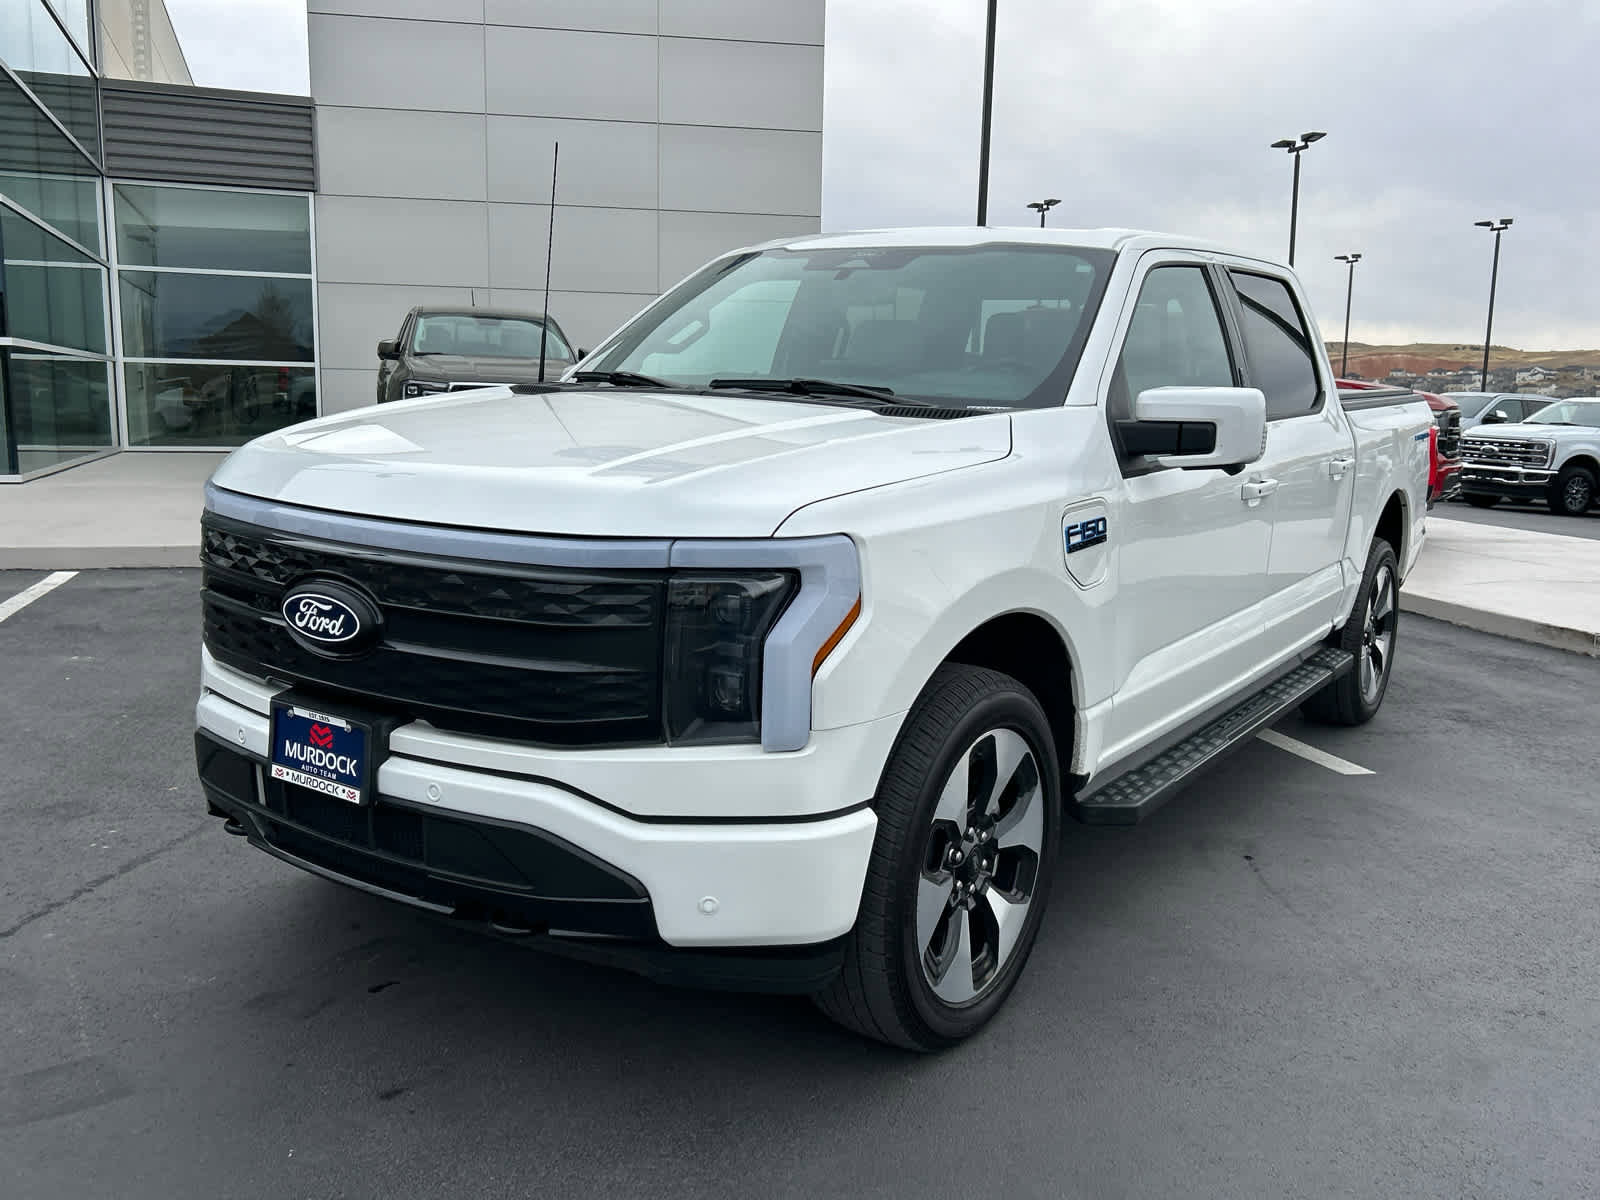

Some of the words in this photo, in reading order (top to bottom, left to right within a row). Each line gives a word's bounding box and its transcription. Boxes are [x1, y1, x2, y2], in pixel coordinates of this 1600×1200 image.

[295, 599, 345, 636] Ford
[285, 739, 357, 777] MURDOCK
[301, 764, 318, 774] AUTO
[320, 769, 337, 780] TEAM
[291, 771, 339, 795] MURDOCK
